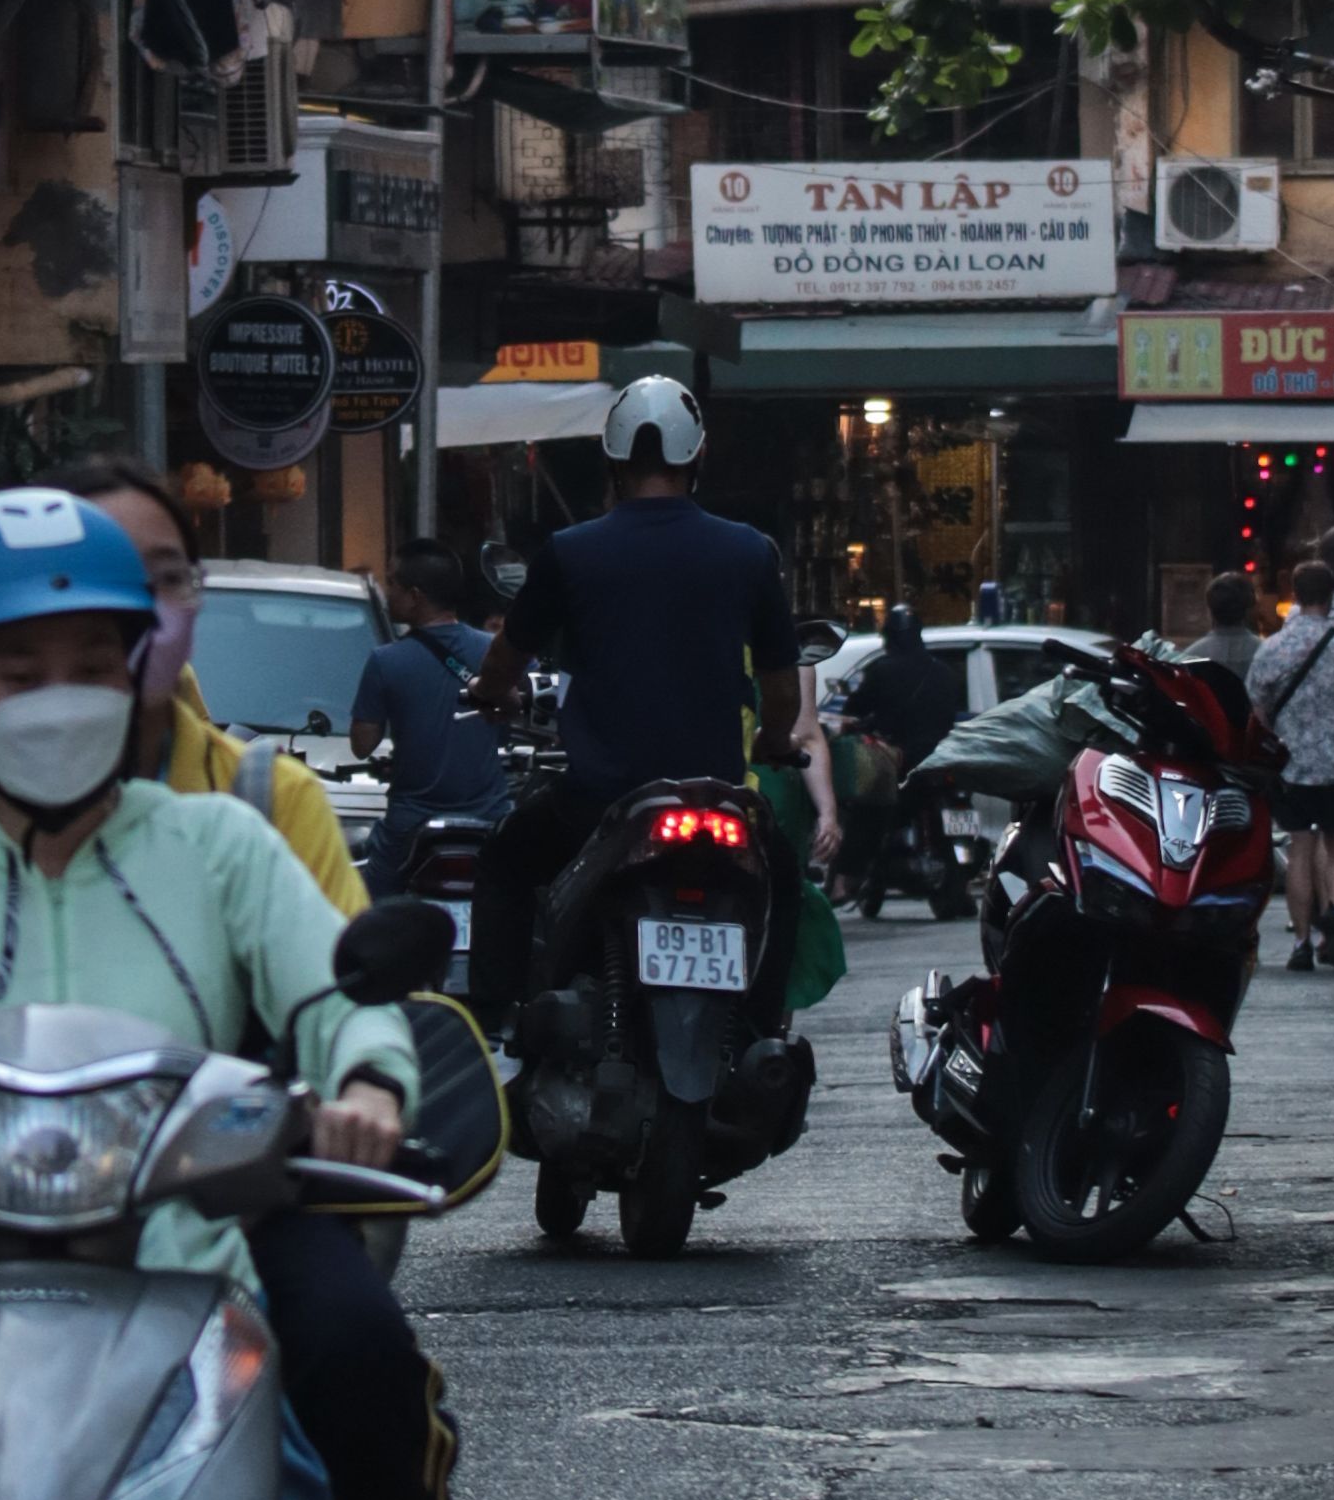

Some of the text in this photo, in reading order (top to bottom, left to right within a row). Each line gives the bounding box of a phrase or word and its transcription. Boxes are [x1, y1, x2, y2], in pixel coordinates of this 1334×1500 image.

[804, 172, 1011, 219] TÂN LẬP
[870, 222, 914, 244] PHONG
[1006, 221, 1028, 241] PHI
[201, 212, 230, 299] DISCOVER
[913, 249, 959, 272] ĐÀI
[967, 253, 1046, 272] LOAN
[227, 322, 305, 346] IMPRESSIVE
[1239, 320, 1328, 364] ĐỨC
[270, 354, 308, 376] HOTEL
[311, 355, 322, 377] 2
[655, 924, 728, 956] 89-B1
[645, 953, 740, 987] 677.54
